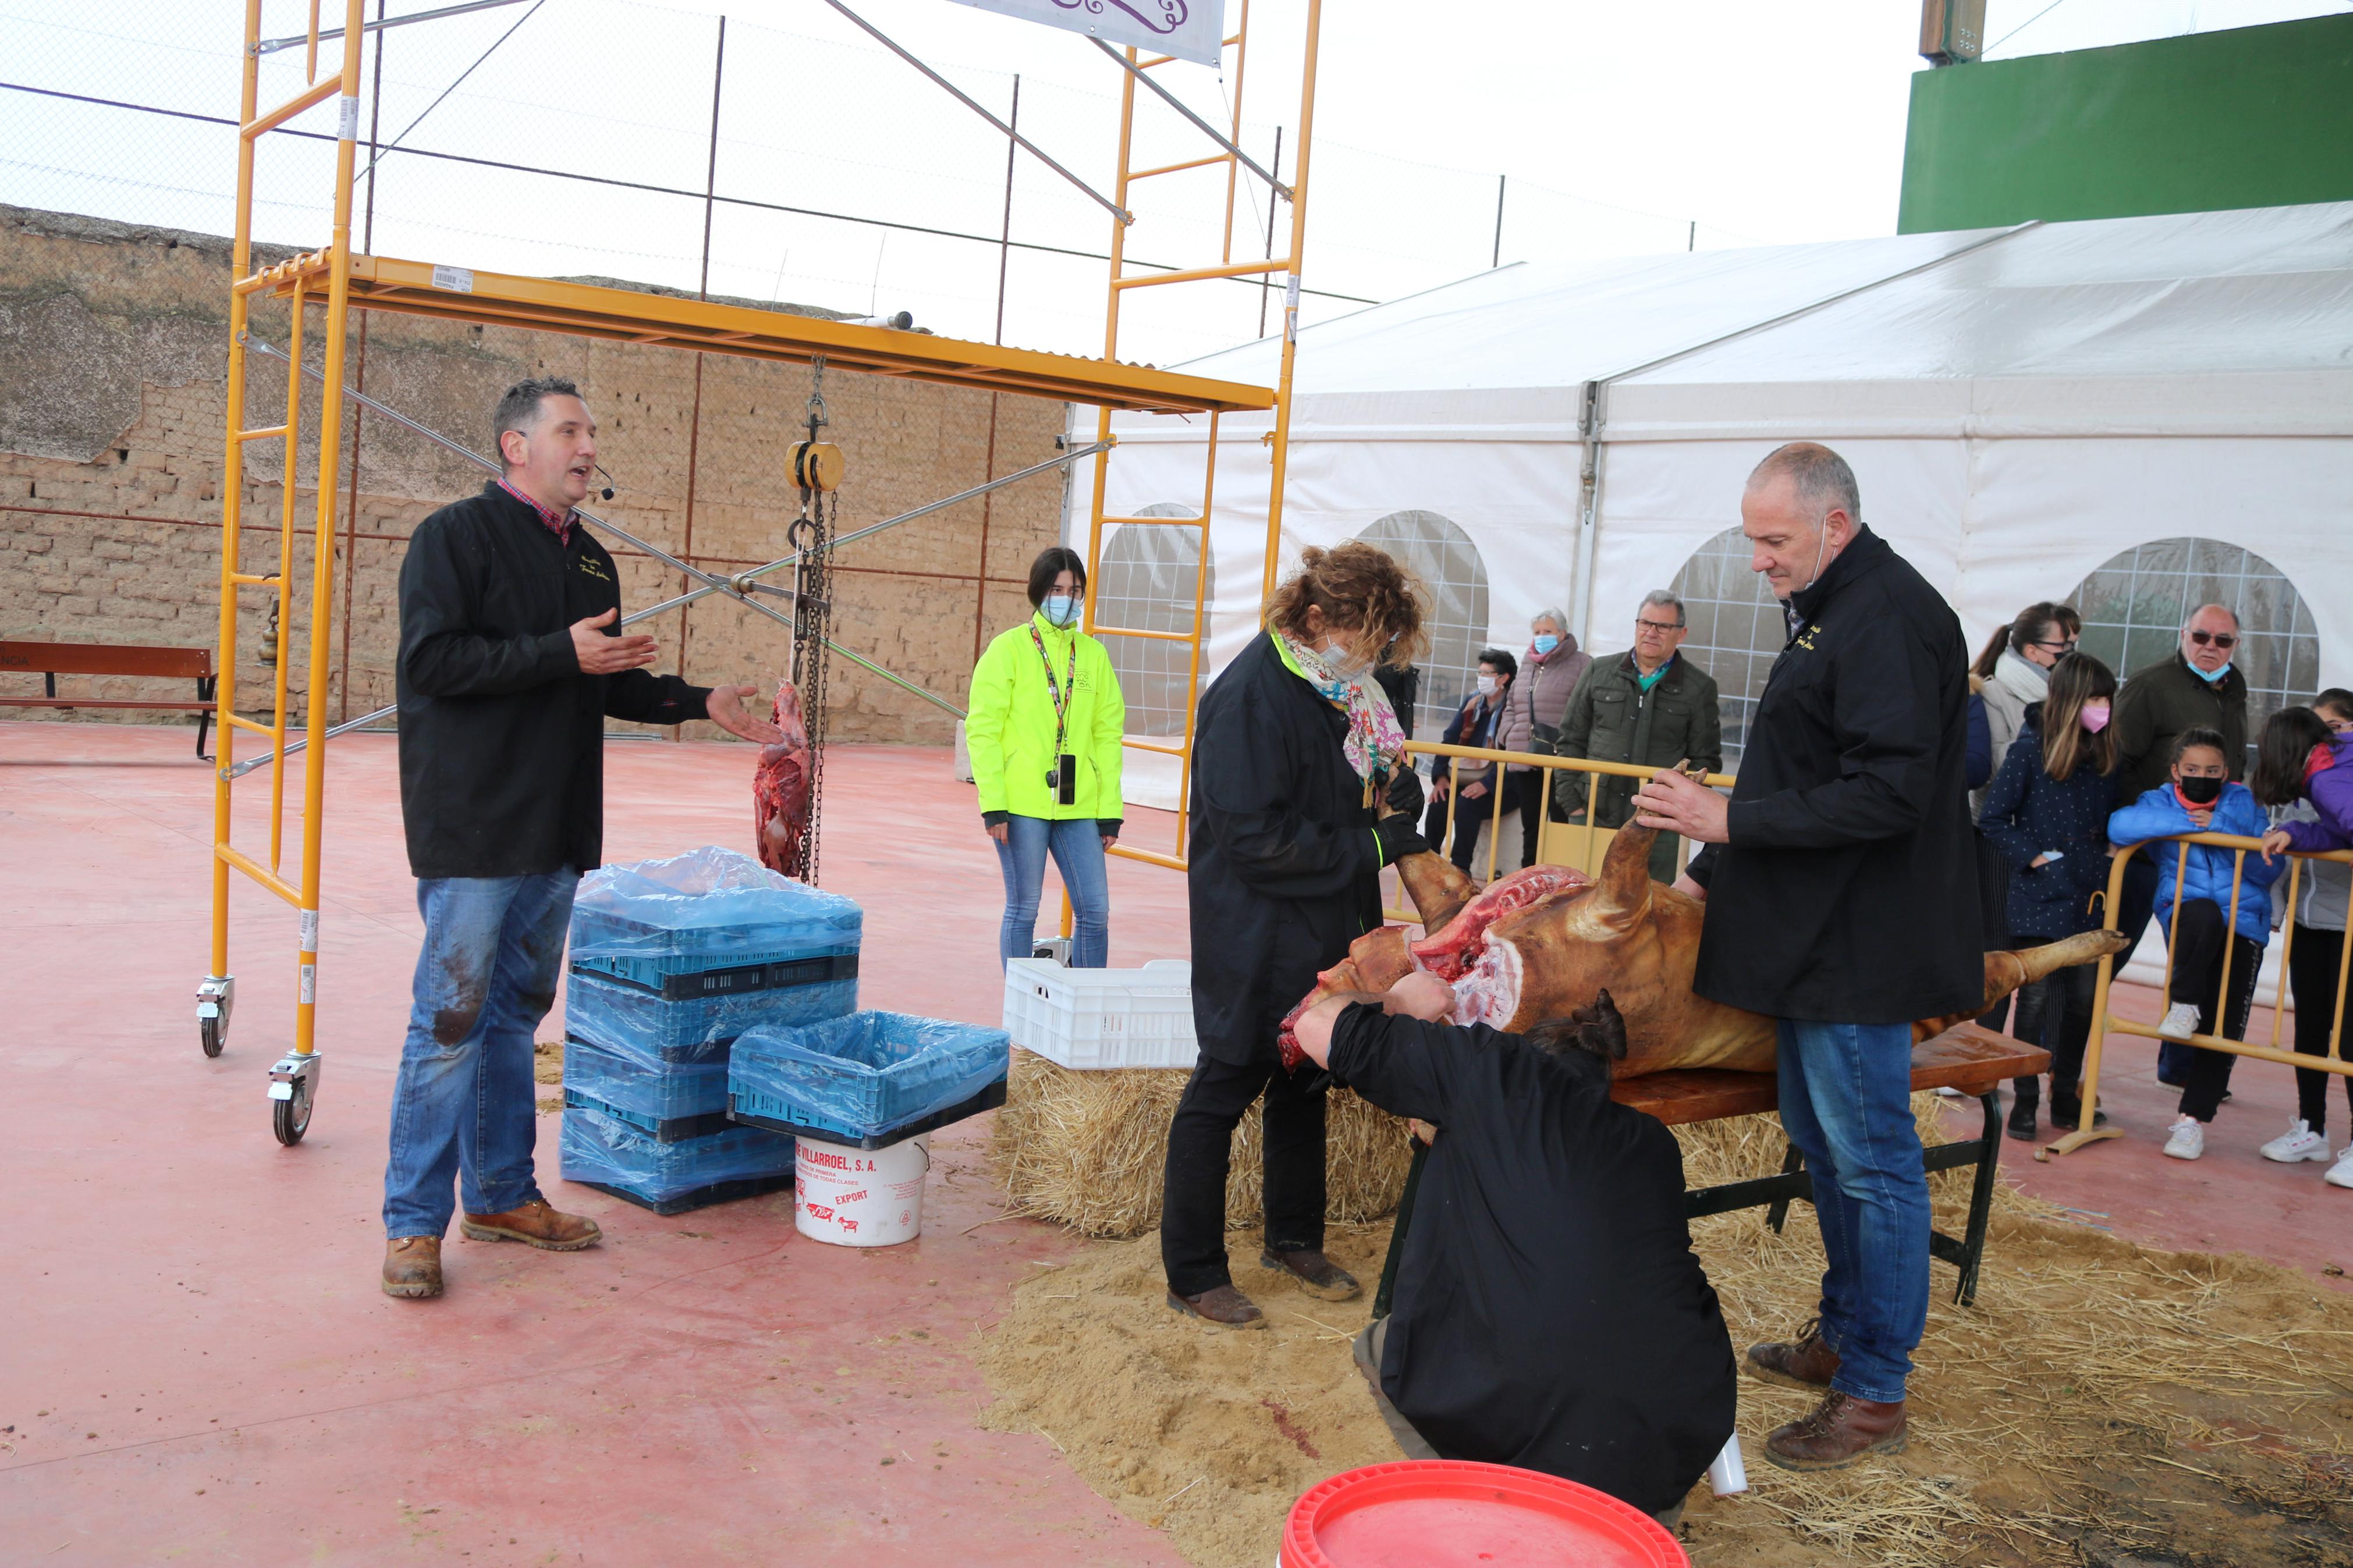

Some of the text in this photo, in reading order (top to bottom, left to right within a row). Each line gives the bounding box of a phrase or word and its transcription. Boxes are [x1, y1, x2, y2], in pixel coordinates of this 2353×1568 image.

[801, 1146, 851, 1173] VILLARROEL,
[856, 1160, 864, 1171] S.
[867, 1160, 876, 1171] A.
[815, 1168, 836, 1177] PRIMERA
[835, 1190, 867, 1205] EXPORT
